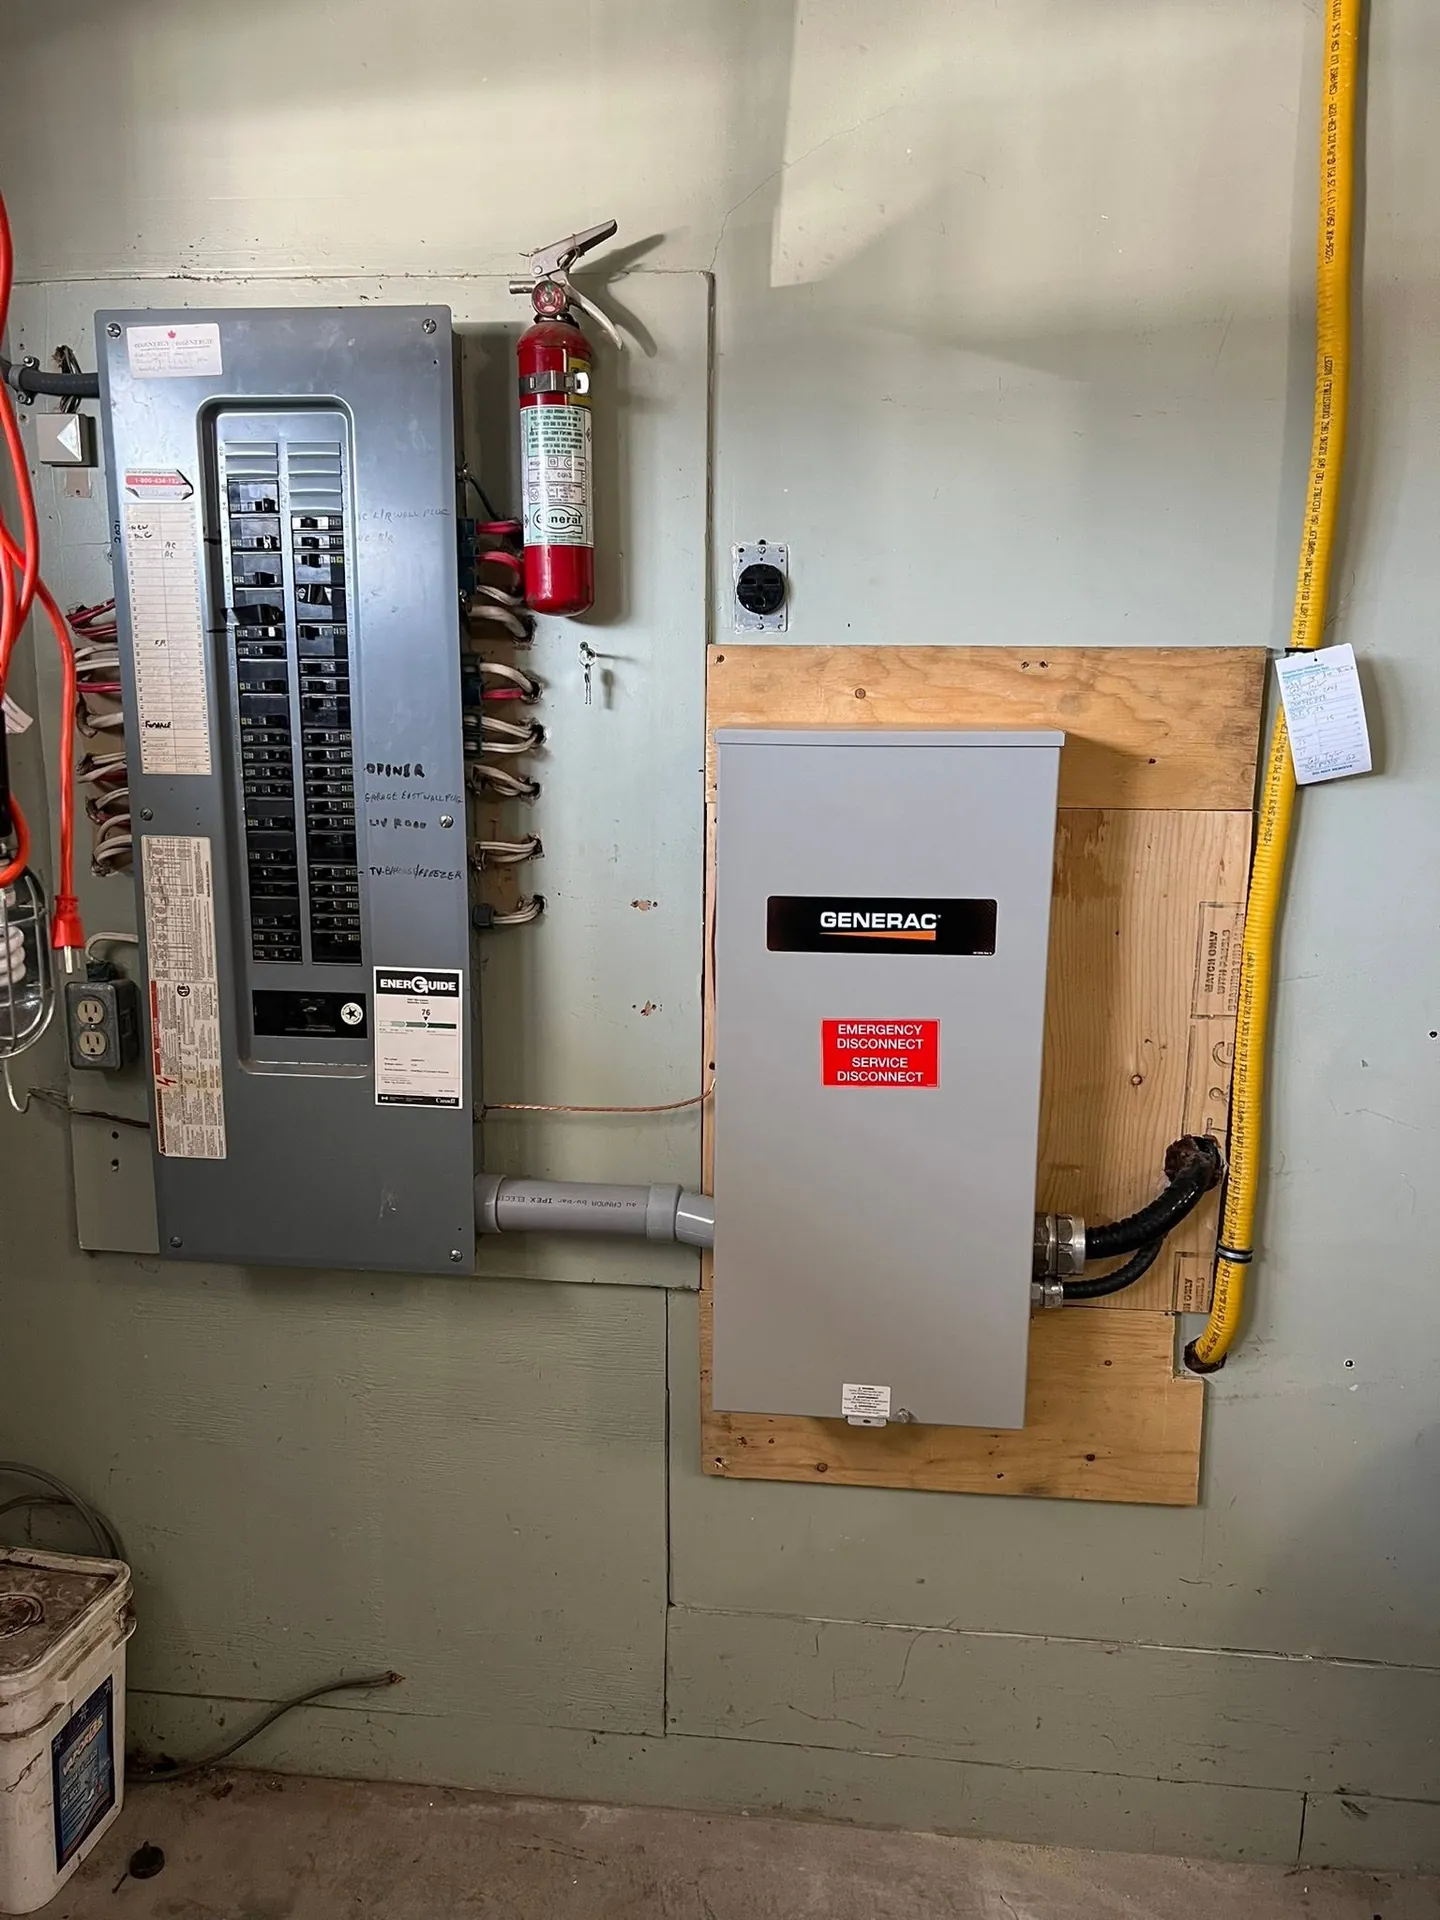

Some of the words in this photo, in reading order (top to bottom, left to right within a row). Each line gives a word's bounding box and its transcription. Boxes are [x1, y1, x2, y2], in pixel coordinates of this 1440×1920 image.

[536, 514, 581, 525] Gneral
[820, 911, 937, 930] GENERAC
[1208, 931, 1218, 957] ONLY
[421, 1008, 431, 1016] 76
[837, 1023, 923, 1035] EMERGENCY
[836, 1038, 924, 1050] DISCONNECT
[851, 1057, 908, 1068] SERVICE
[836, 1071, 924, 1082] DISCONNECT
[529, 1196, 553, 1204] IPEX
[591, 1200, 622, 1208] CANADA
